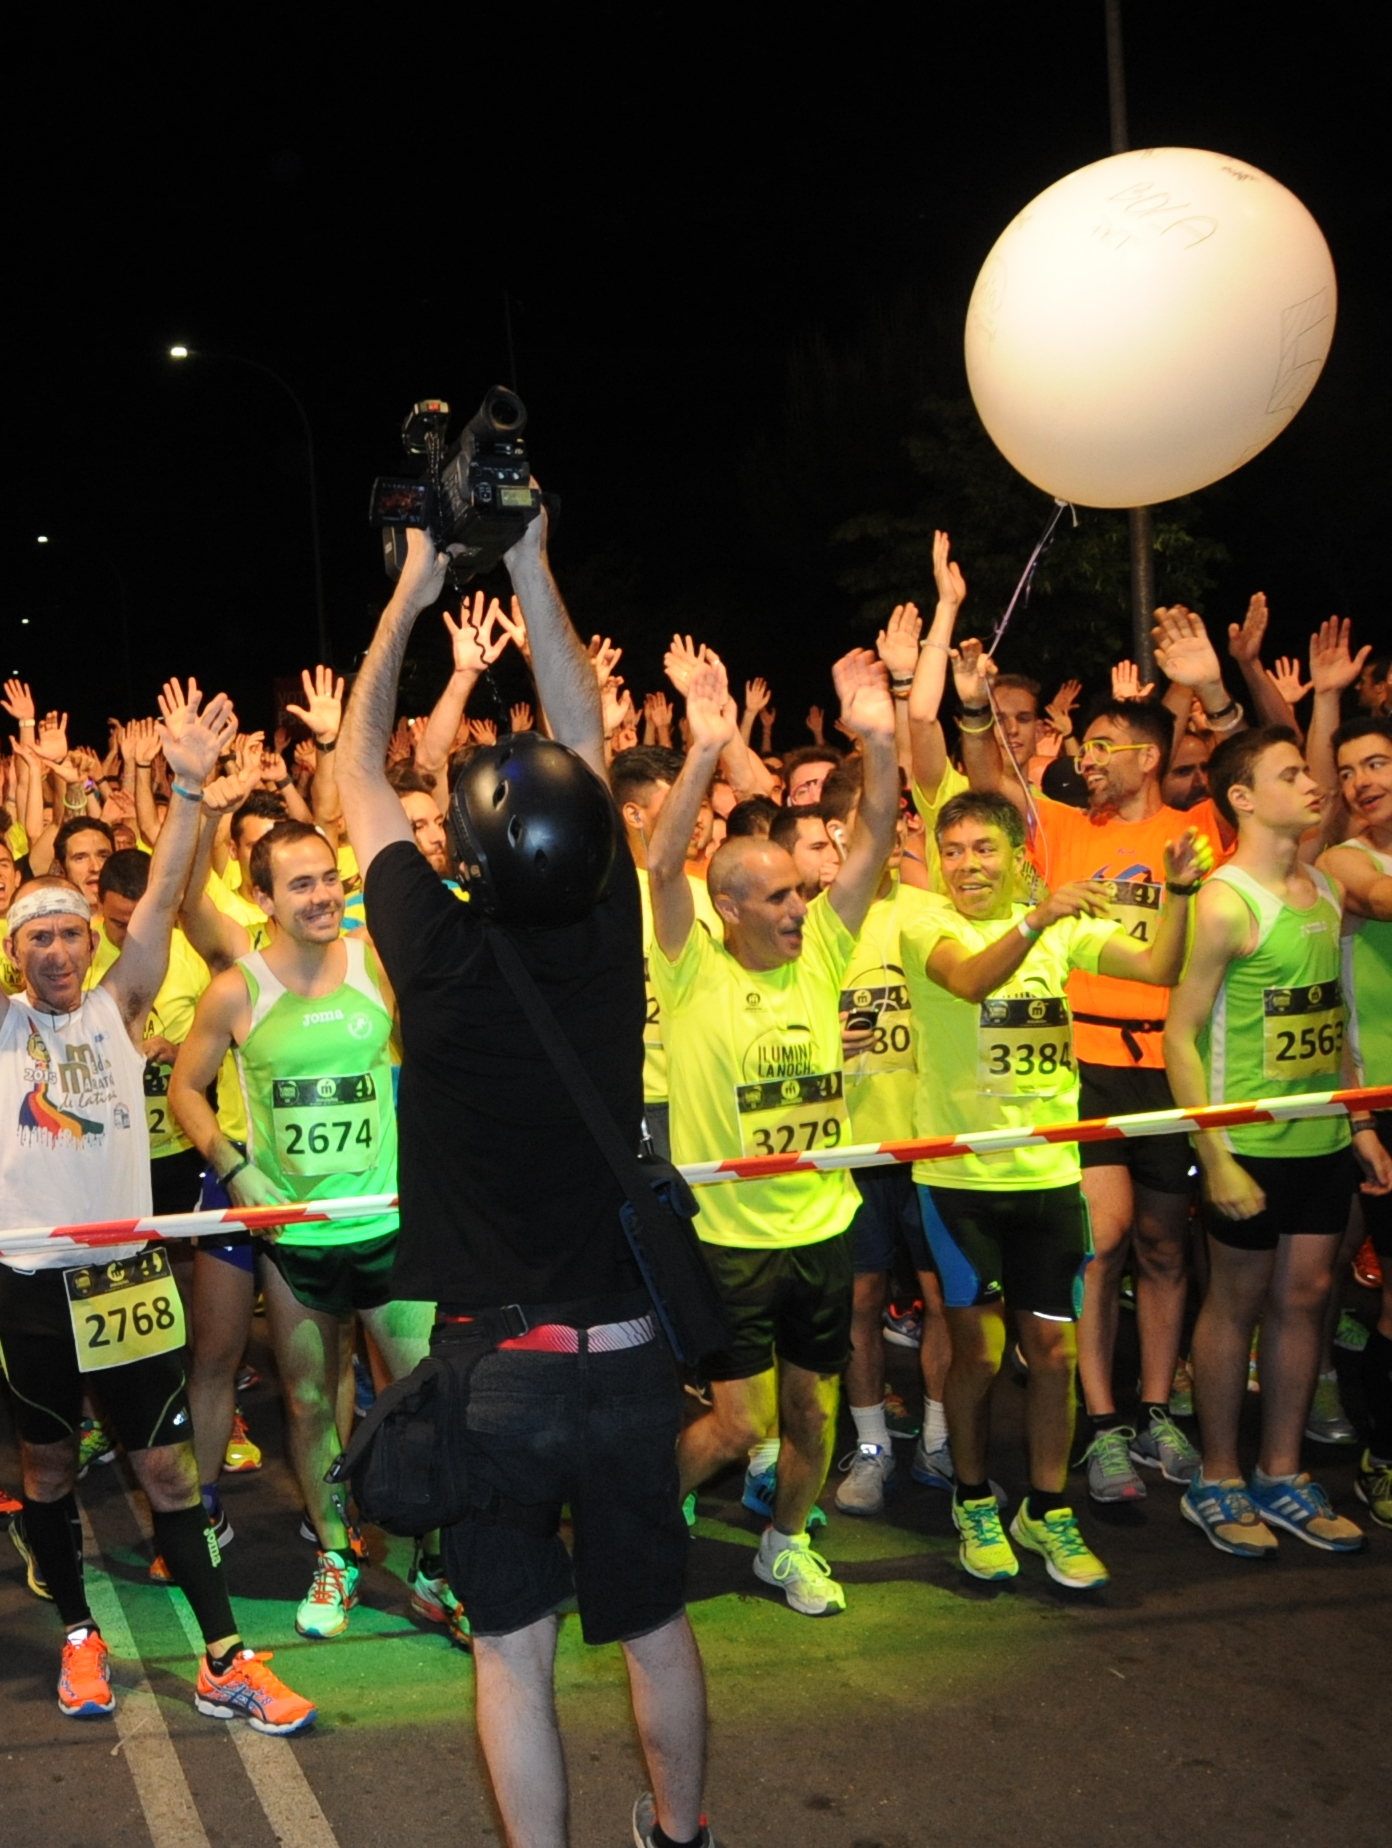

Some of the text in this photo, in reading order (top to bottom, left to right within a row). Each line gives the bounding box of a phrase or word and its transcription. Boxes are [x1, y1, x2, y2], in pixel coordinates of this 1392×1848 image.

[24, 1068, 58, 1085] 2015
[989, 1042, 1071, 1076] 3384
[285, 1118, 372, 1155] 2674
[752, 1118, 842, 1156] 3279
[85, 1296, 175, 1348] 2768
